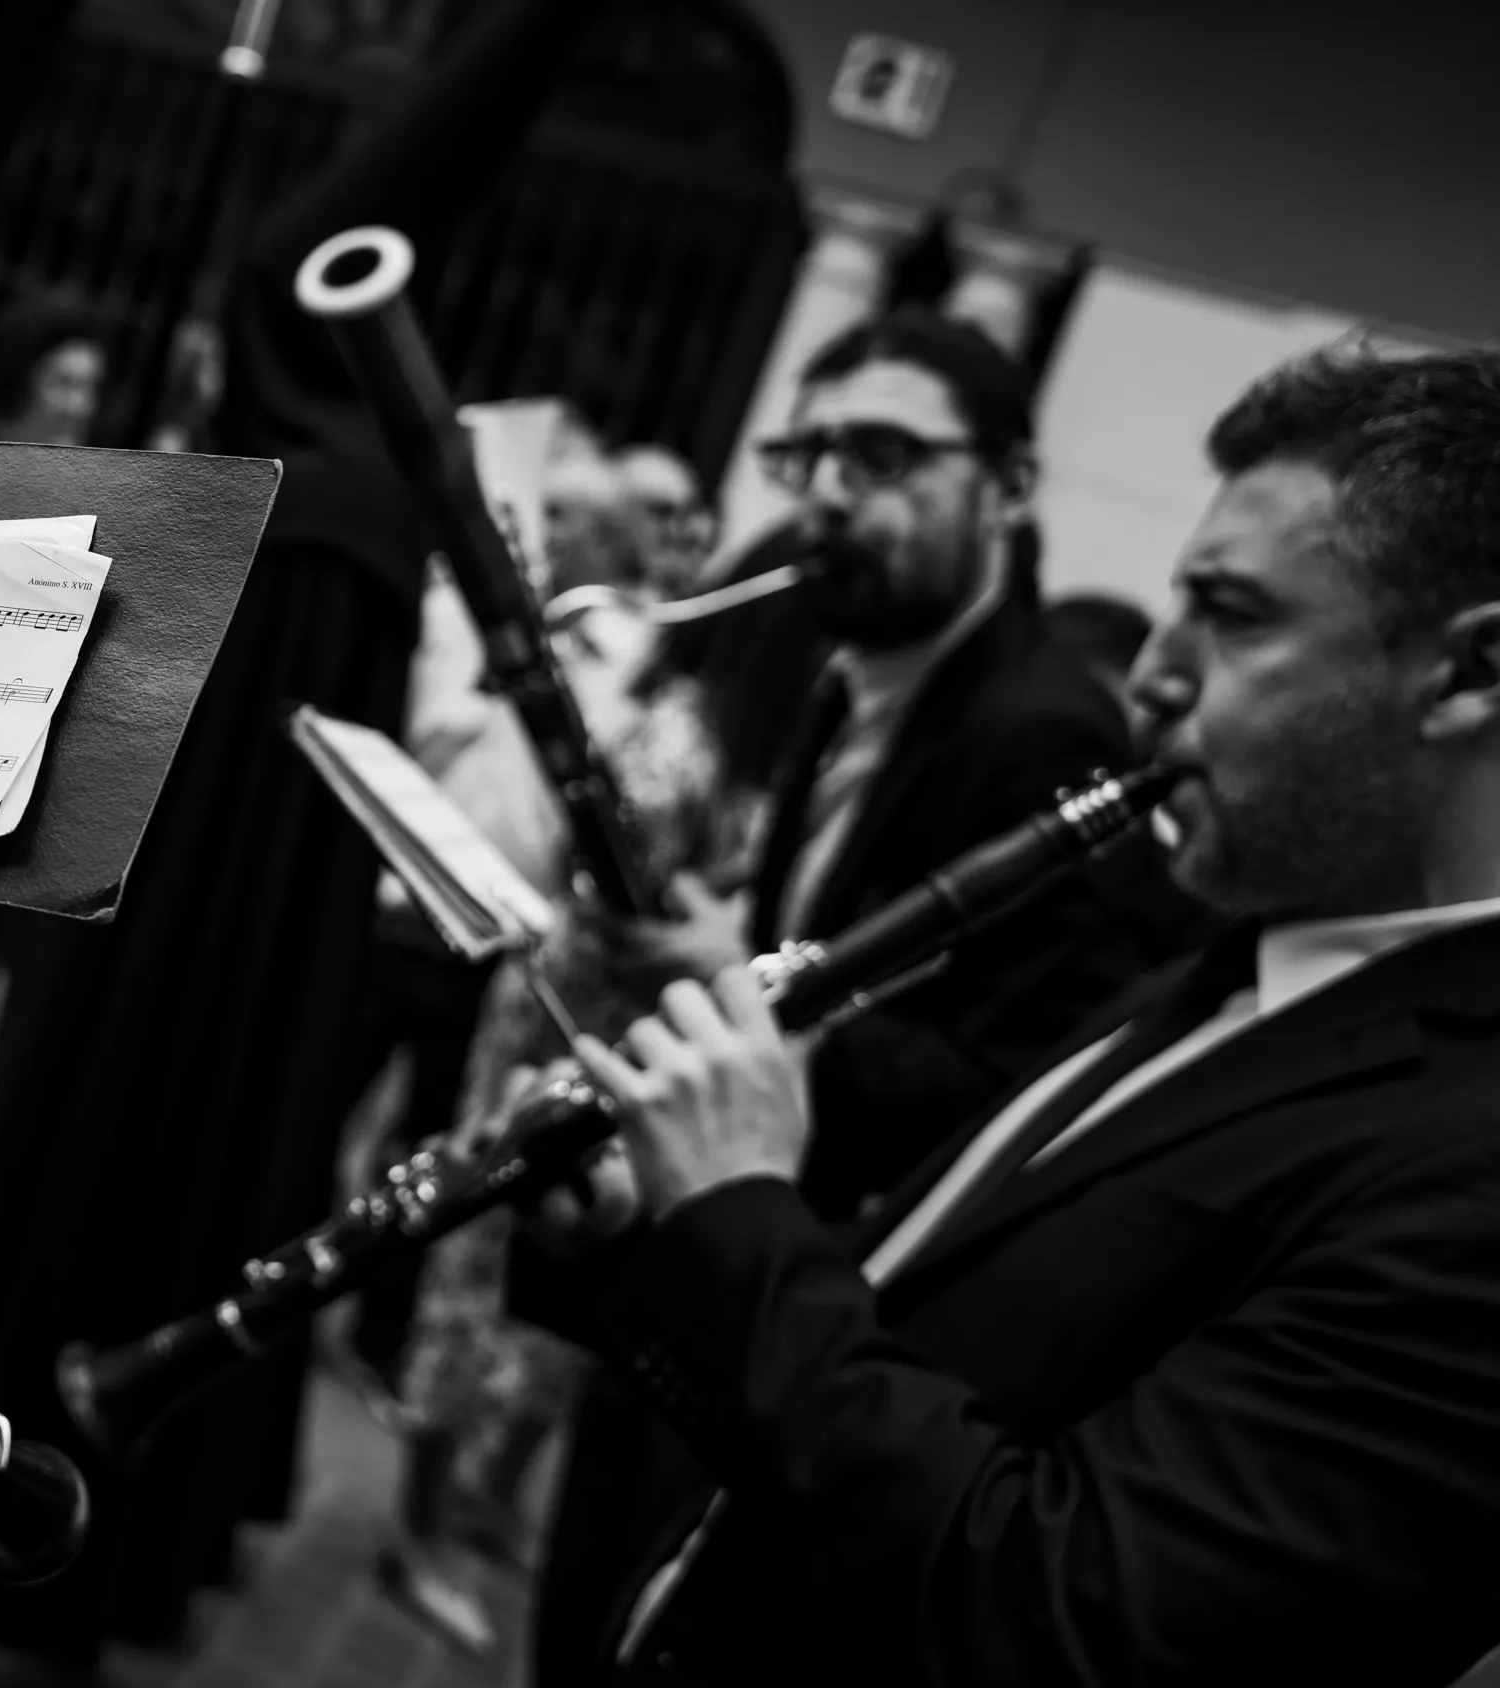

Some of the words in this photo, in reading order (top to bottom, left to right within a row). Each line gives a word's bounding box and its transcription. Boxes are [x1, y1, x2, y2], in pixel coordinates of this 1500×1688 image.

[27, 577, 61, 588] Anónimo
[61, 580, 69, 589] S.
[70, 581, 93, 591] XVIII
